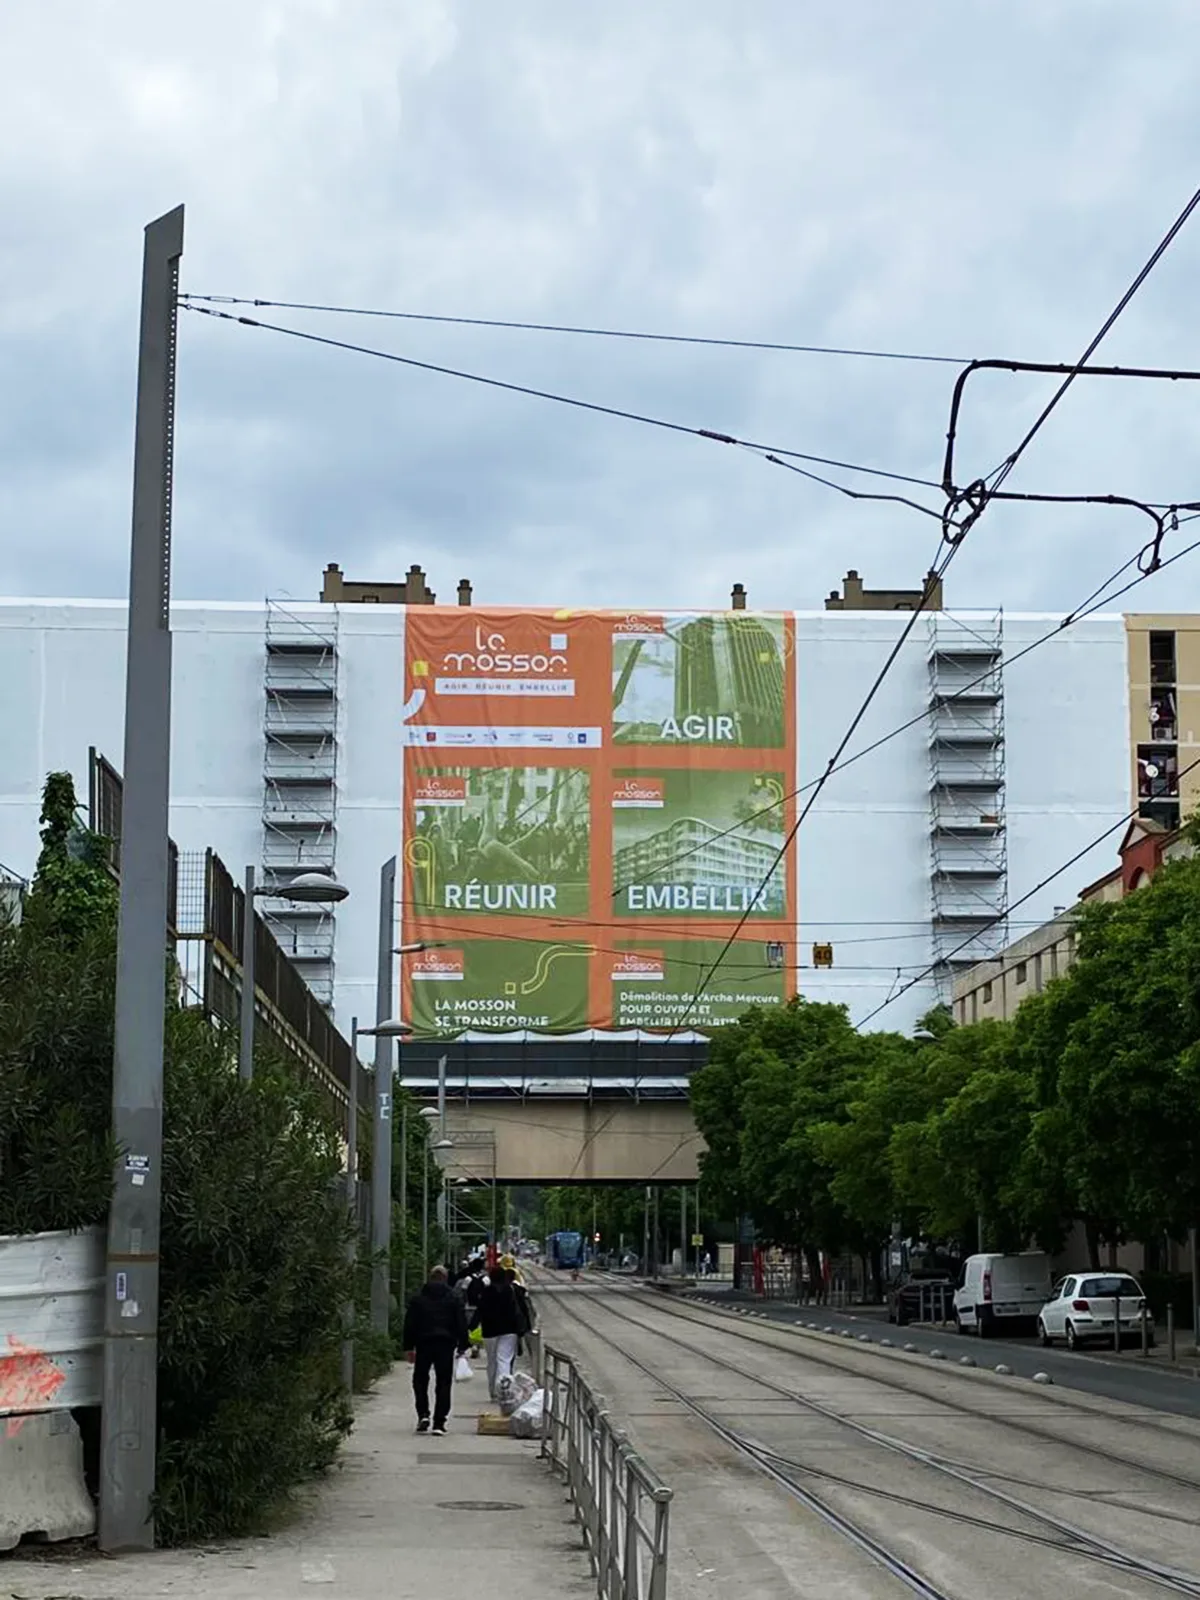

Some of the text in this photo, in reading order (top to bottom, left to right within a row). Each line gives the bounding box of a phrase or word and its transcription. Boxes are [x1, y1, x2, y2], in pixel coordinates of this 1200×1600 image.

[660, 714, 734, 740] AGIR
[444, 878, 557, 910] RÉUNIR
[627, 885, 769, 912] EMBELLIR
[620, 991, 679, 1002] Démolition
[681, 992, 695, 1002] de
[735, 993, 780, 1004] Mercure
[434, 1000, 516, 1011] LA MOSSON
[620, 1004, 652, 1014] POUR
[699, 1004, 711, 1014] ET
[434, 1016, 549, 1027] SE TRANSFORME
